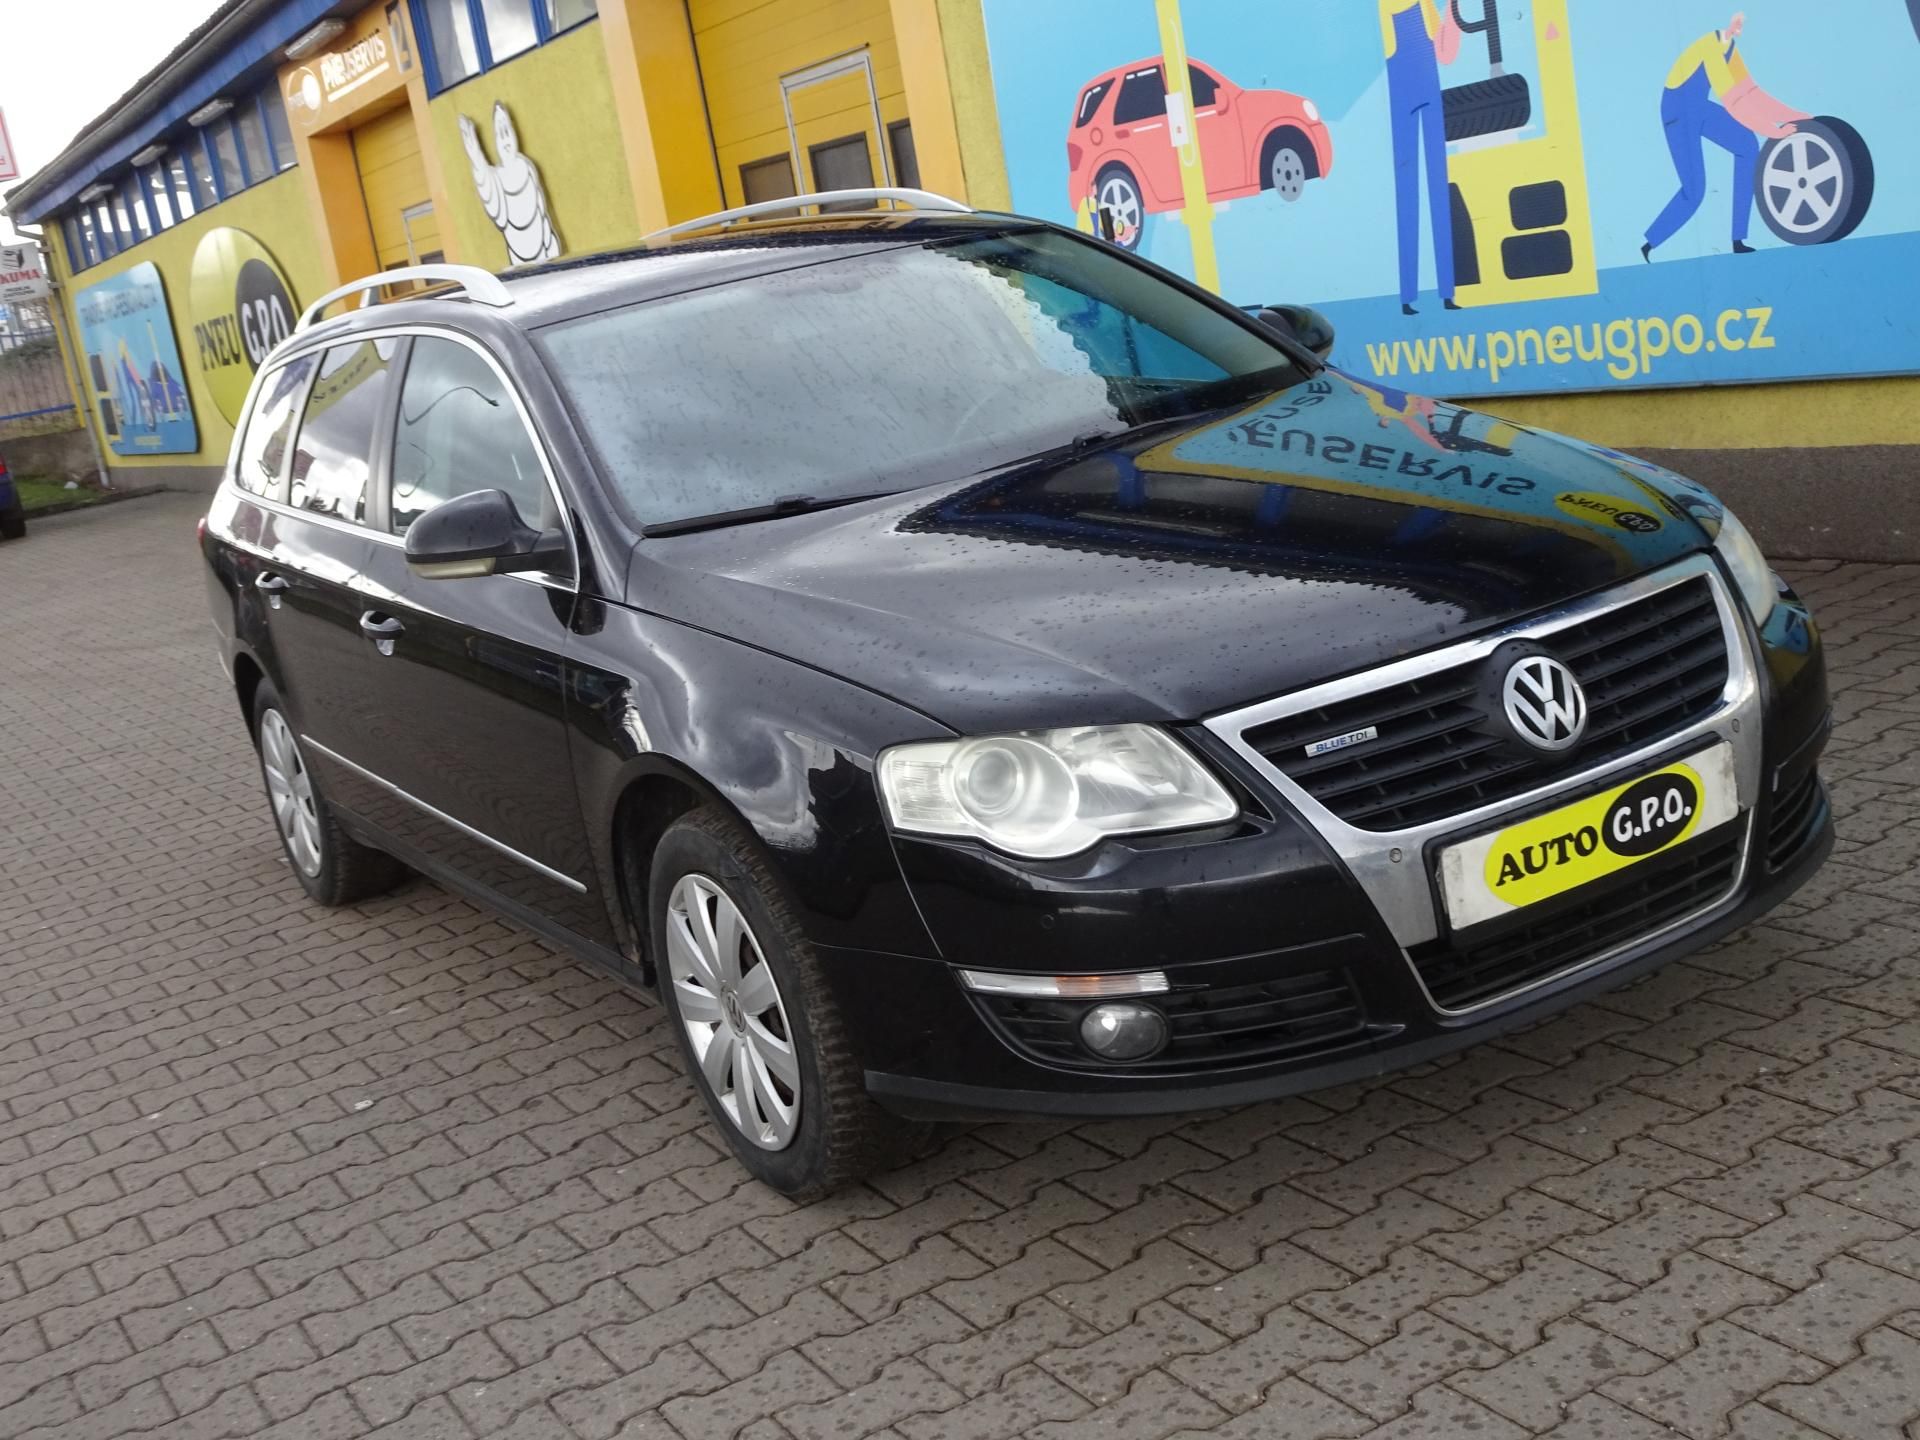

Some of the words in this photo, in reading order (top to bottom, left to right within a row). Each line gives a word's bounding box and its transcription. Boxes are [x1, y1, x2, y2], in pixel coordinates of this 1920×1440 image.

[194, 313, 242, 372] PNEU
[1366, 306, 1775, 383] www.pneugpo.cz
[1495, 825, 1599, 887] AUTO
[1612, 788, 1692, 843] G.P.O.
